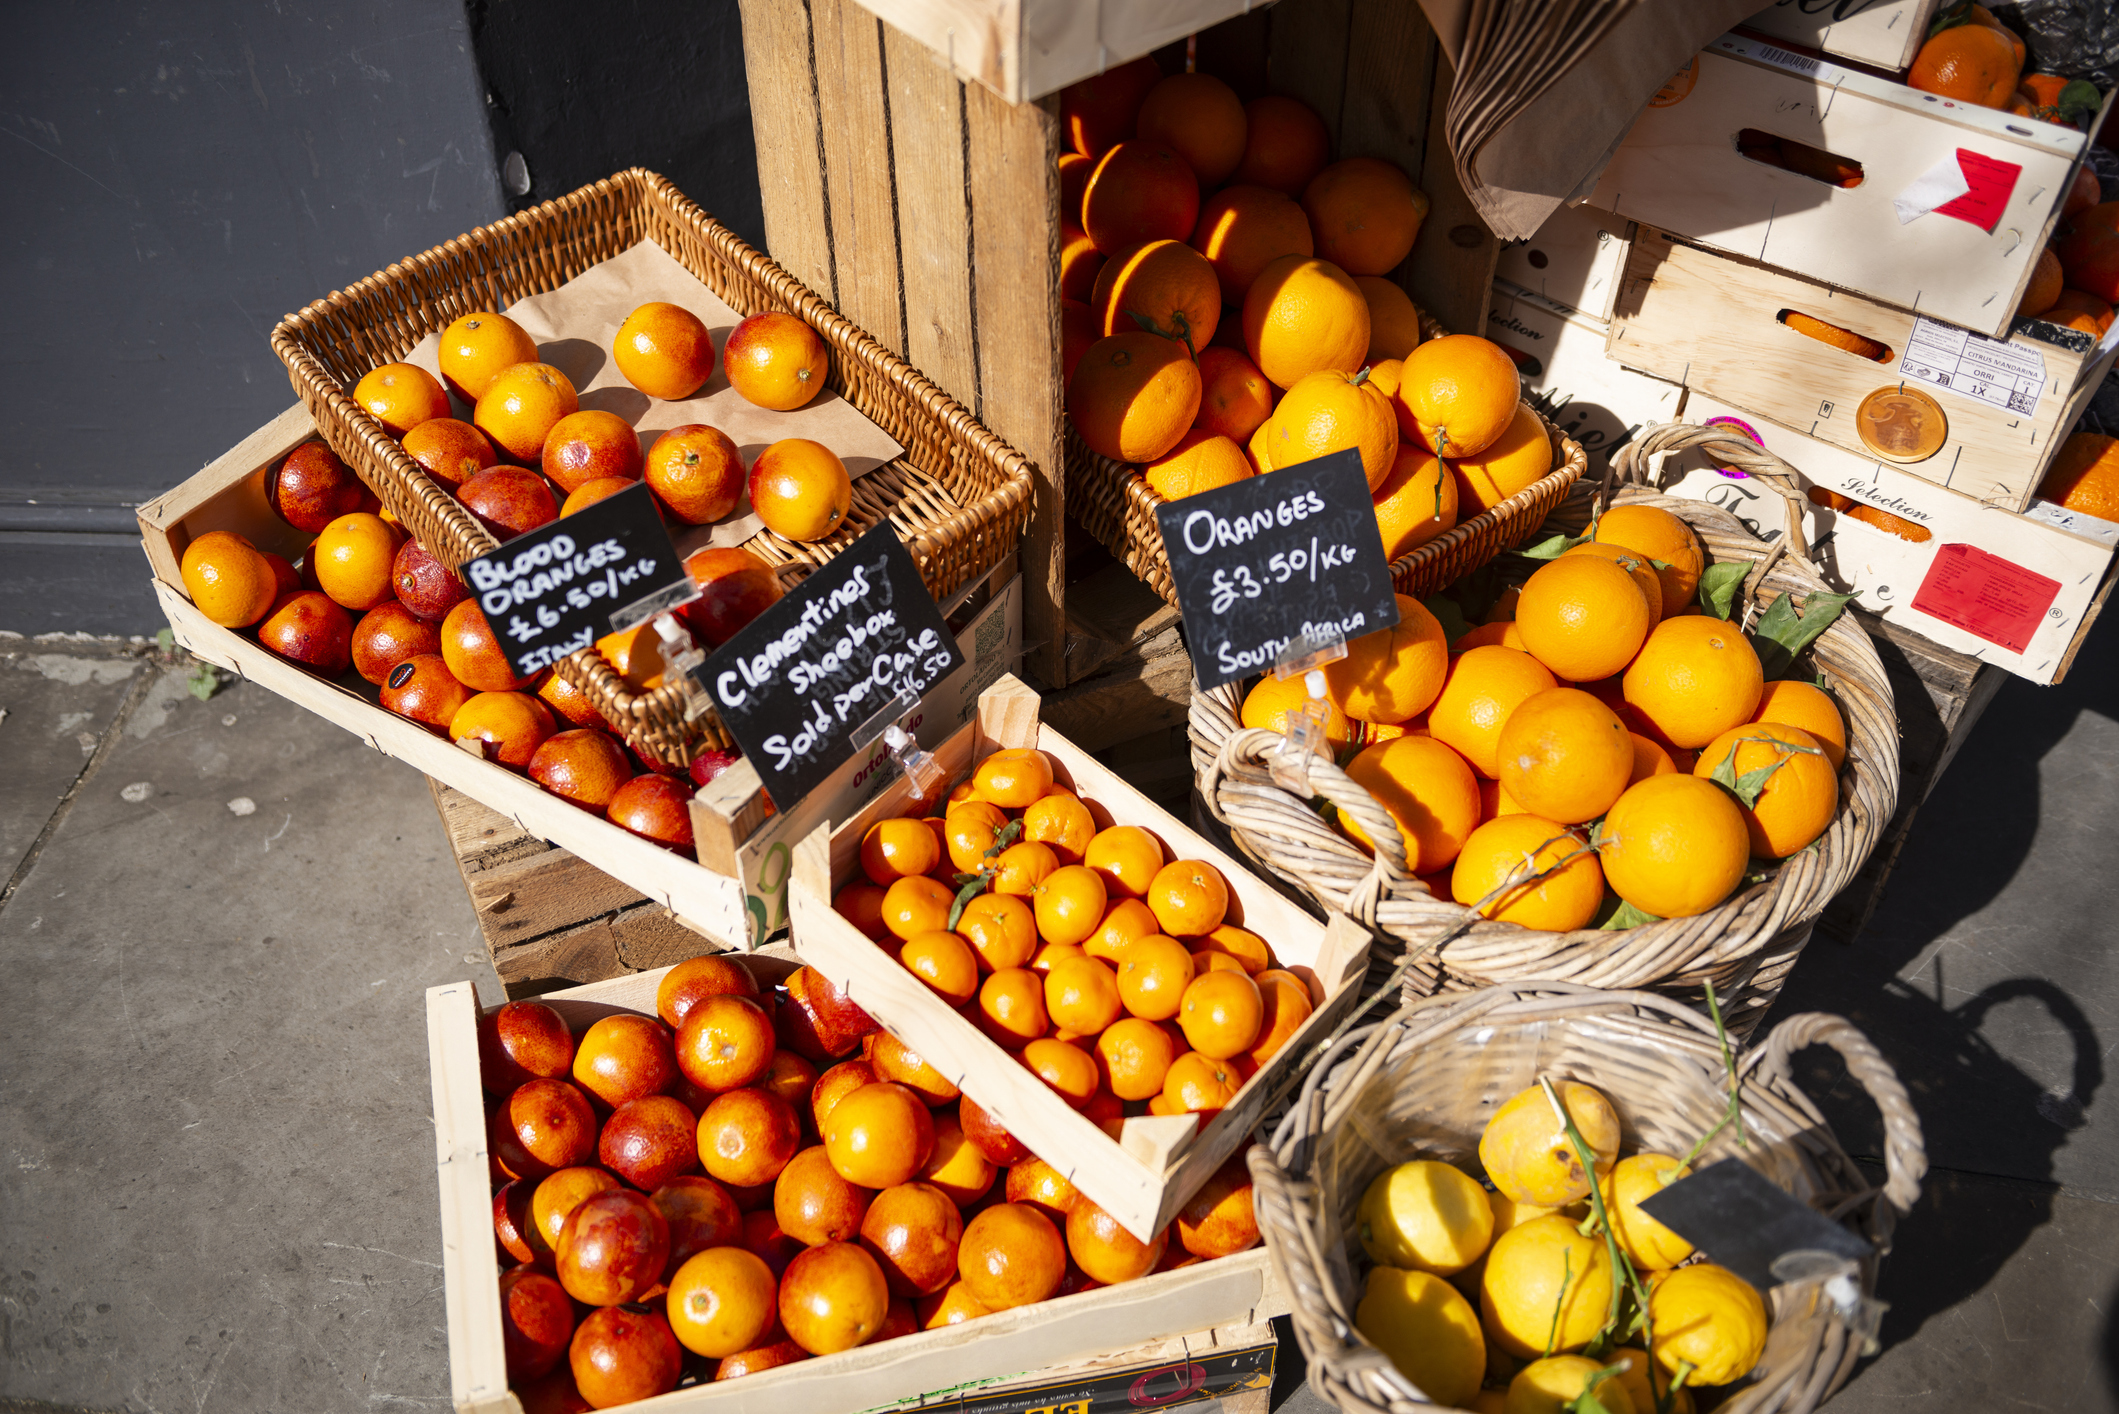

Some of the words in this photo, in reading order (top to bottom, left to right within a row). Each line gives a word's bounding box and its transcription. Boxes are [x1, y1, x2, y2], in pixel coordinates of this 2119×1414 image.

[1488, 309, 1545, 341] lection
[1967, 351, 1993, 364] CITRUS
[1994, 358, 2038, 378] MANDARINA
[1970, 385, 1987, 397] 1X
[1973, 369, 1995, 381] ORRI
[1183, 490, 1325, 555] ORANGES
[1841, 478, 1934, 522] Selection
[468, 534, 576, 592] BLOOD
[481, 538, 627, 616] ORANGES
[1210, 536, 1357, 615] £3.50/KG
[507, 558, 657, 643] £6.50/KG
[1300, 611, 1366, 644] AFRICA
[517, 626, 593, 675] ITALY
[717, 565, 870, 707] Clementines
[892, 651, 952, 707] £16.50
[762, 699, 832, 772] Sold
[853, 713, 923, 789] Ortoldo
